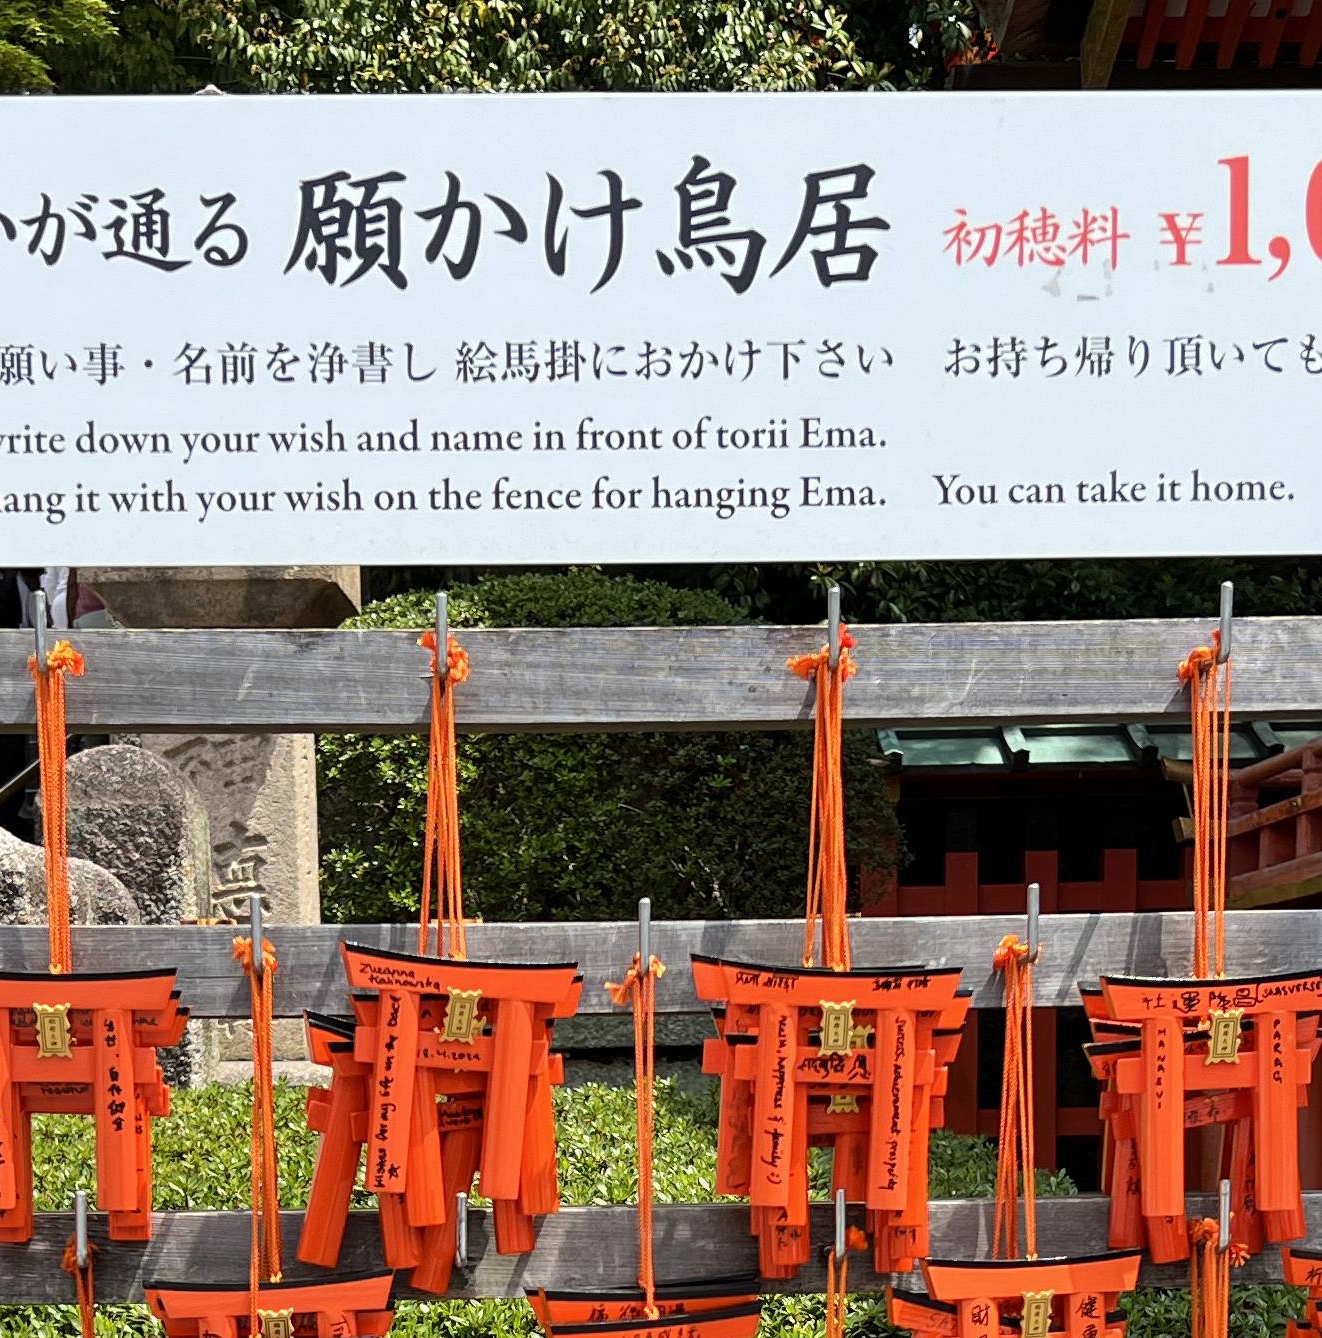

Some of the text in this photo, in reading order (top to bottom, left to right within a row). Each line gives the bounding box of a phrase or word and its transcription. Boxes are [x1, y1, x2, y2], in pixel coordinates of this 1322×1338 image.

[283, 155, 891, 294] 願かけ鳥居
[942, 205, 1131, 270] 初穂料
[456, 340, 894, 383] 絵馬掛におかけ下さい
[76, 420, 170, 453] down
[181, 433, 260, 463] your
[269, 419, 345, 452] wish
[357, 418, 419, 451] and
[431, 431, 522, 451] name
[534, 422, 565, 450] in
[577, 417, 662, 450] front
[672, 416, 713, 449] of
[717, 419, 788, 448] torii
[802, 418, 887, 447] Ema.
[76, 483, 99, 512] it
[109, 479, 185, 512] with
[197, 491, 276, 522] your
[285, 478, 362, 511] wish
[374, 491, 417, 510] on
[429, 477, 481, 510] the
[493, 477, 581, 510] fence
[593, 476, 642, 509] for
[653, 476, 790, 520] hanging
[801, 476, 887, 506] Ema.
[934, 469, 1295, 504] You can take it home.
